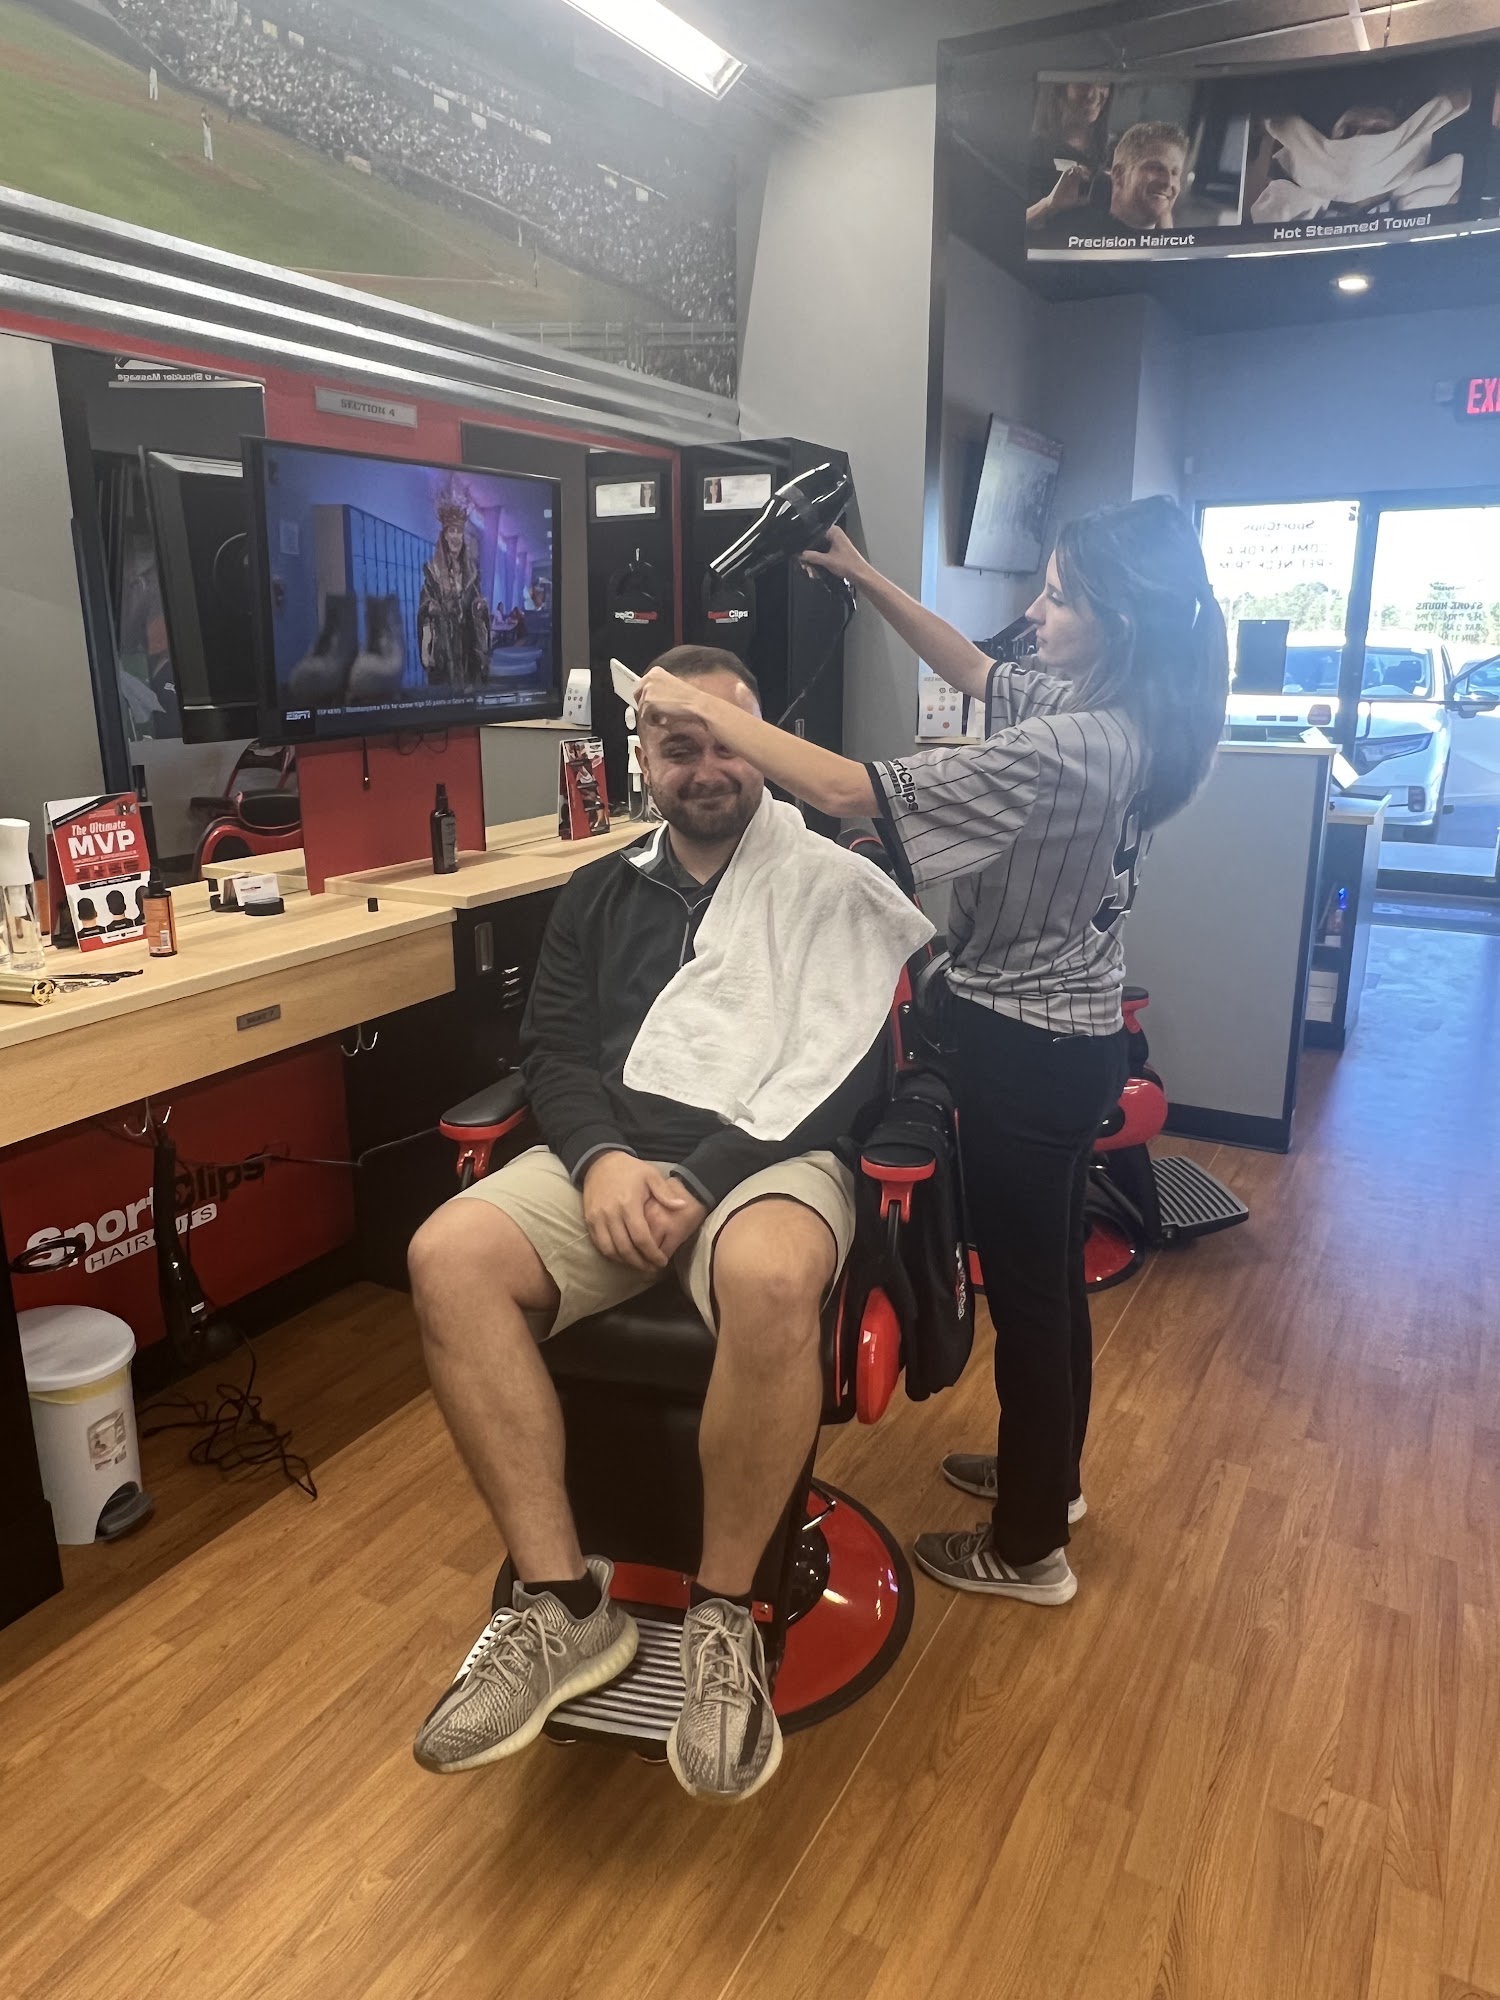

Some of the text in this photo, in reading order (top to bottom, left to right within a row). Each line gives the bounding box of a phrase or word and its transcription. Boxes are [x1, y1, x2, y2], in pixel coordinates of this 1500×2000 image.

[1273, 213, 1432, 240] Hot Steamed Towel
[1068, 234, 1195, 248] Precision Haircut
[340, 398, 396, 417] SECTION 4
[71, 820, 127, 837] The Ultimate
[67, 829, 135, 859] MVP
[90, 1204, 214, 1270] HAIRUTS
